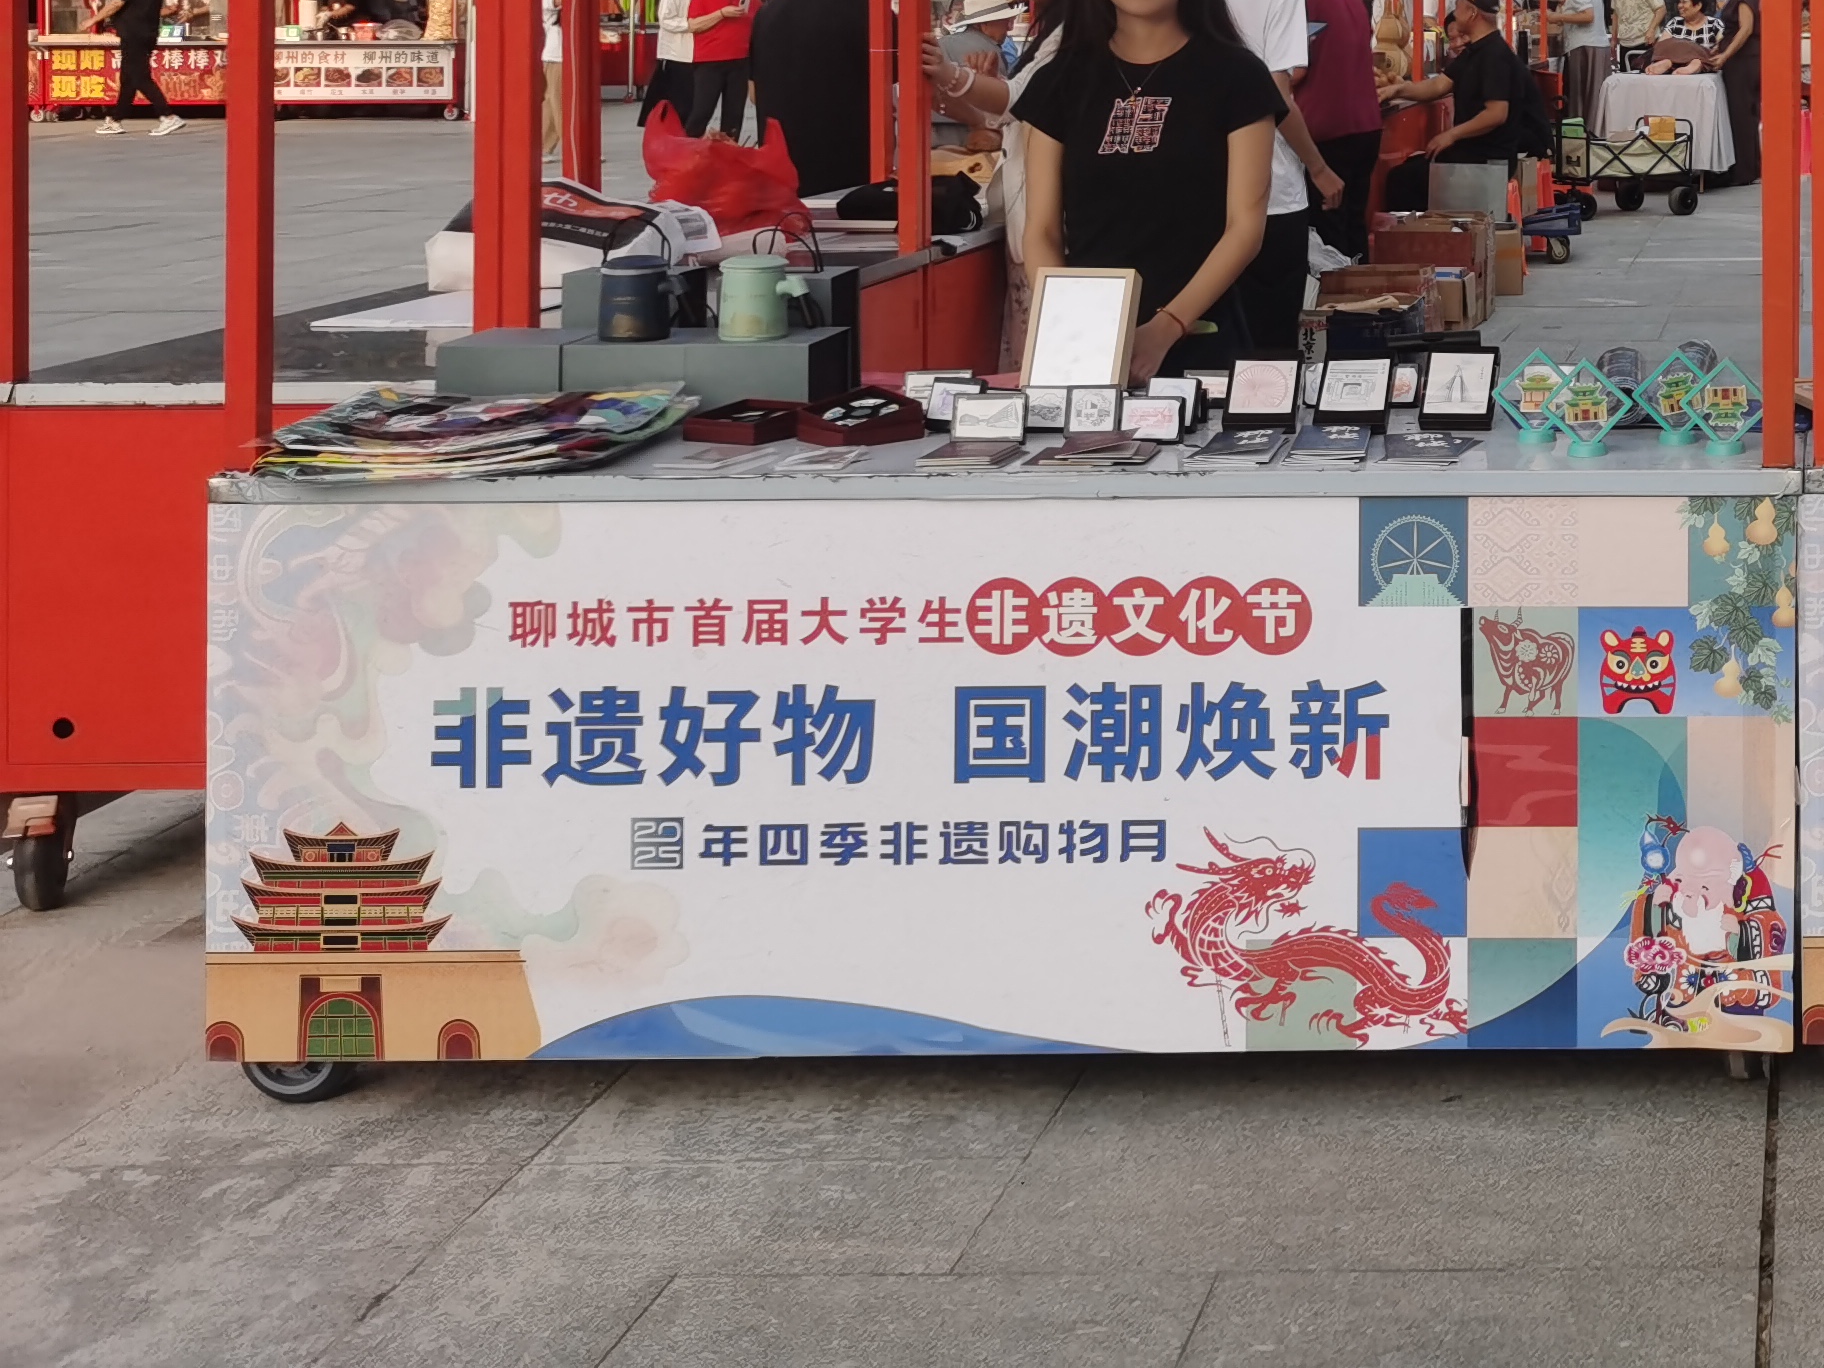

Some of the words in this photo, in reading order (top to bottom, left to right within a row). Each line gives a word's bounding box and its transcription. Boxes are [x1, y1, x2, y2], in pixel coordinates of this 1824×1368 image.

[52, 49, 106, 71] 现炸
[362, 50, 440, 65] 柳州的味道
[430, 682, 876, 789] 非遗好物
[952, 678, 1390, 785] 国潮焕新
